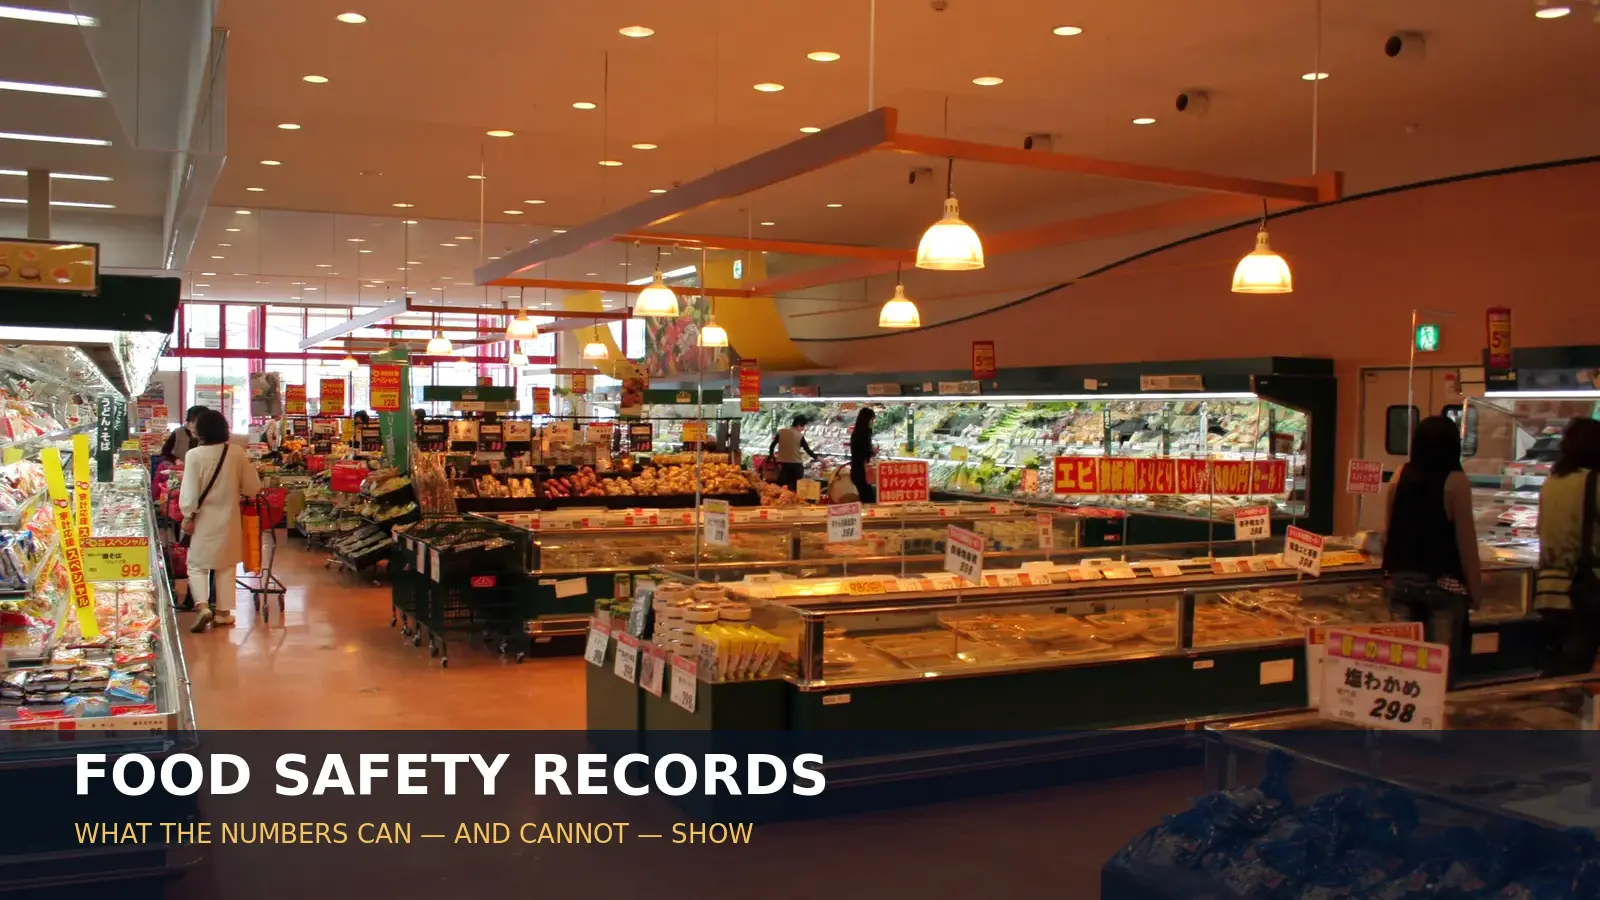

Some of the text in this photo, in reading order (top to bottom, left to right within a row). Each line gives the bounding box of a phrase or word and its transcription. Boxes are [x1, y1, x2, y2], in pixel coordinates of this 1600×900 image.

[101, 397, 111, 451] うどん・そば
[1057, 461, 1094, 491] エビ
[121, 564, 141, 577] 99
[1344, 667, 1421, 698] 塩わかめ
[1369, 698, 1417, 723] 298
